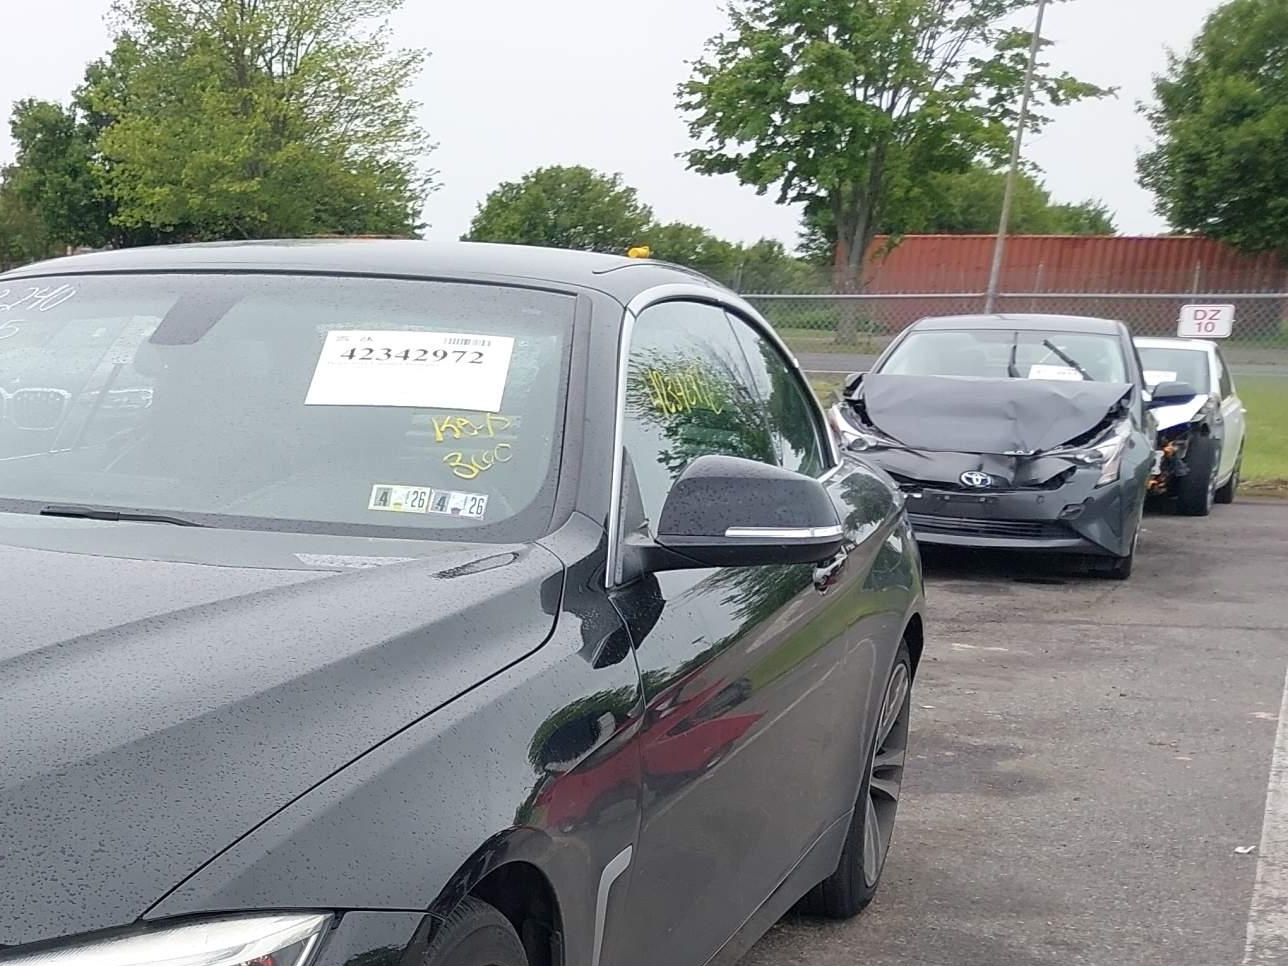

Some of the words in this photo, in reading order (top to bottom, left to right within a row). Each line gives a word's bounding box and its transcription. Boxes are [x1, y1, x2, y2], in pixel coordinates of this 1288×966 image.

[1193, 309, 1221, 321] DZ
[1196, 321, 1216, 333] 10
[340, 347, 485, 365] 42342972
[379, 491, 389, 507] 4
[437, 495, 447, 512] 4
